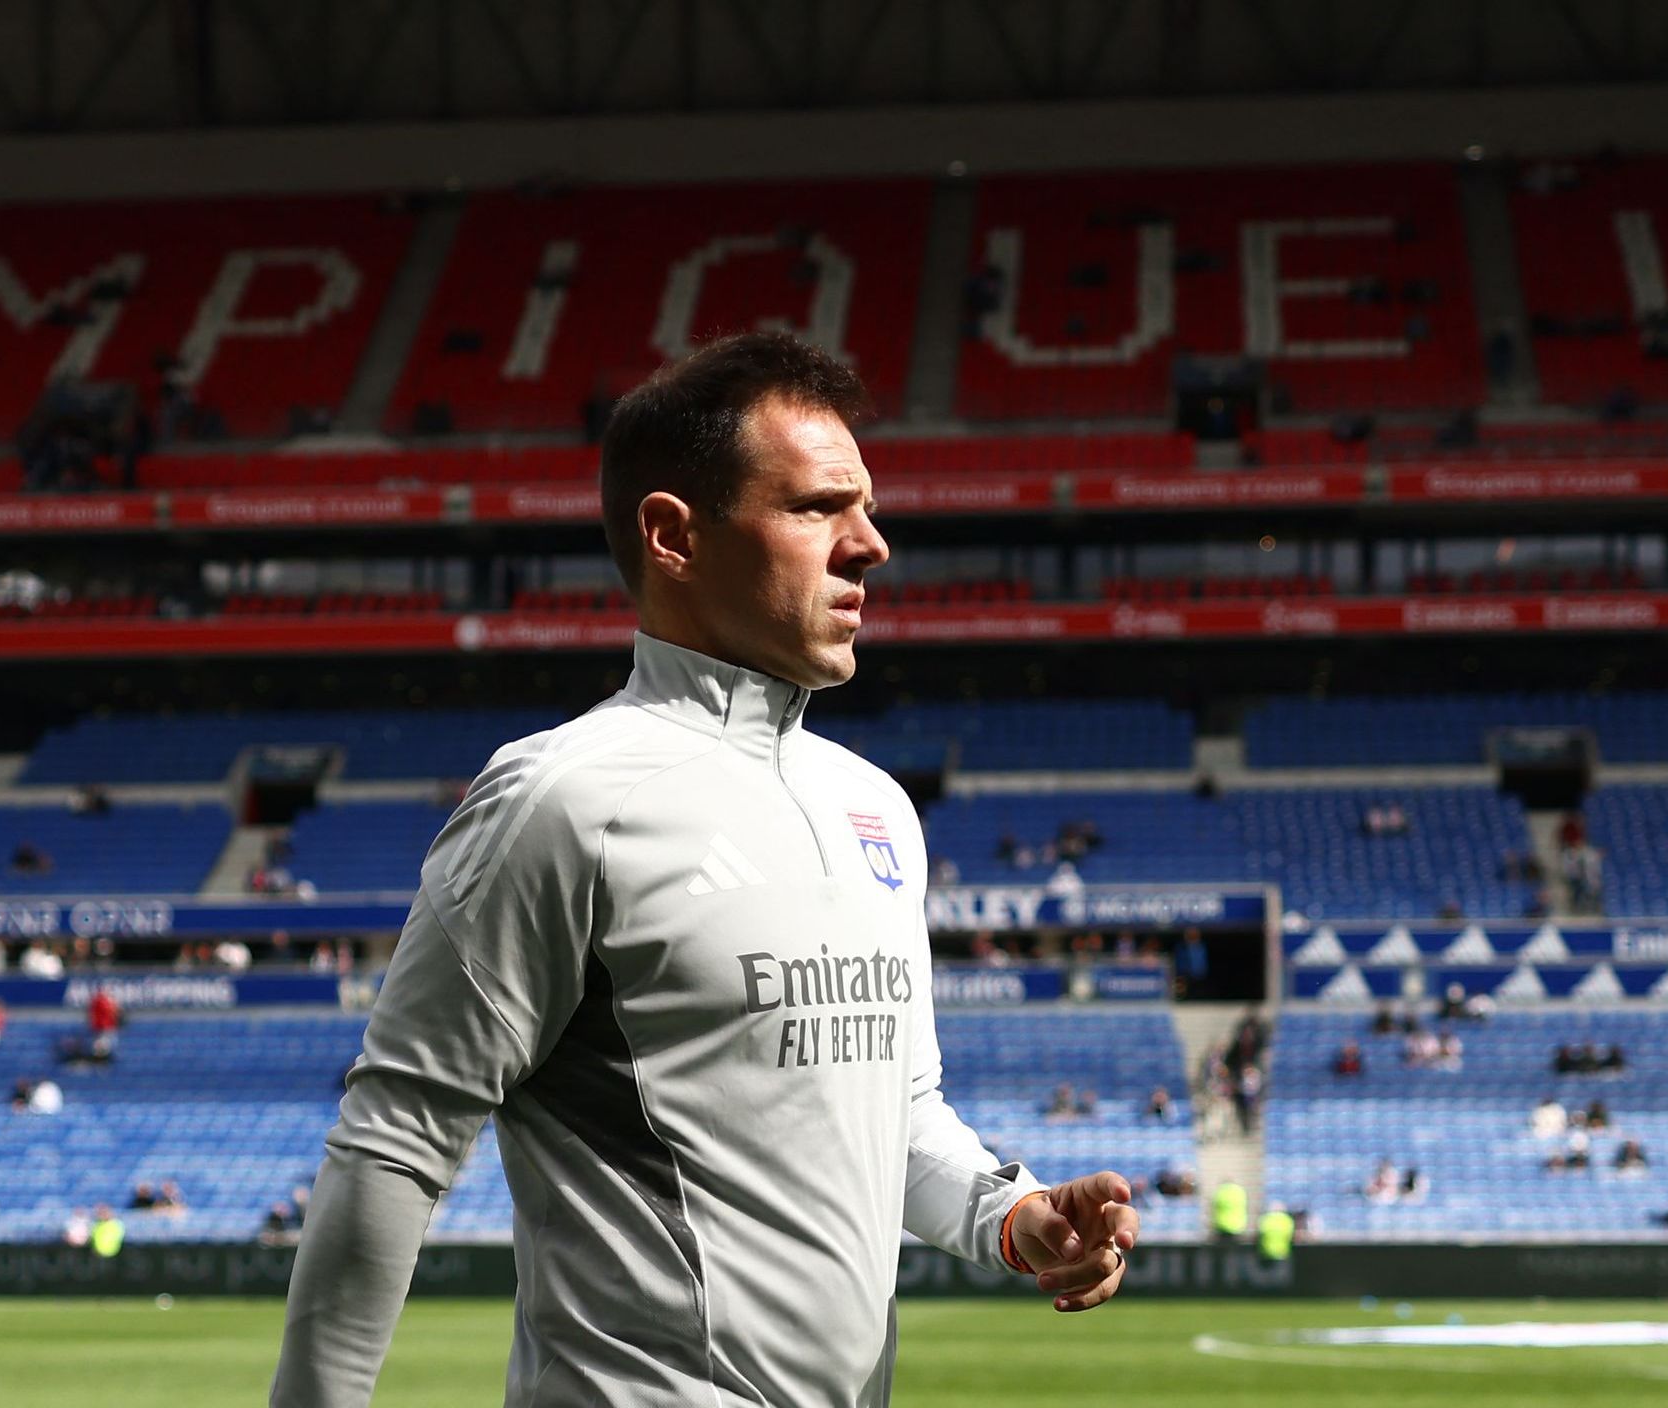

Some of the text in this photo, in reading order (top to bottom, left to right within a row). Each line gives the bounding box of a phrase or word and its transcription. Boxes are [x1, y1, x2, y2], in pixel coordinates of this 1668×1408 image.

[736, 943, 912, 1013] Emirates
[778, 1014, 896, 1068] FLY BETTER
